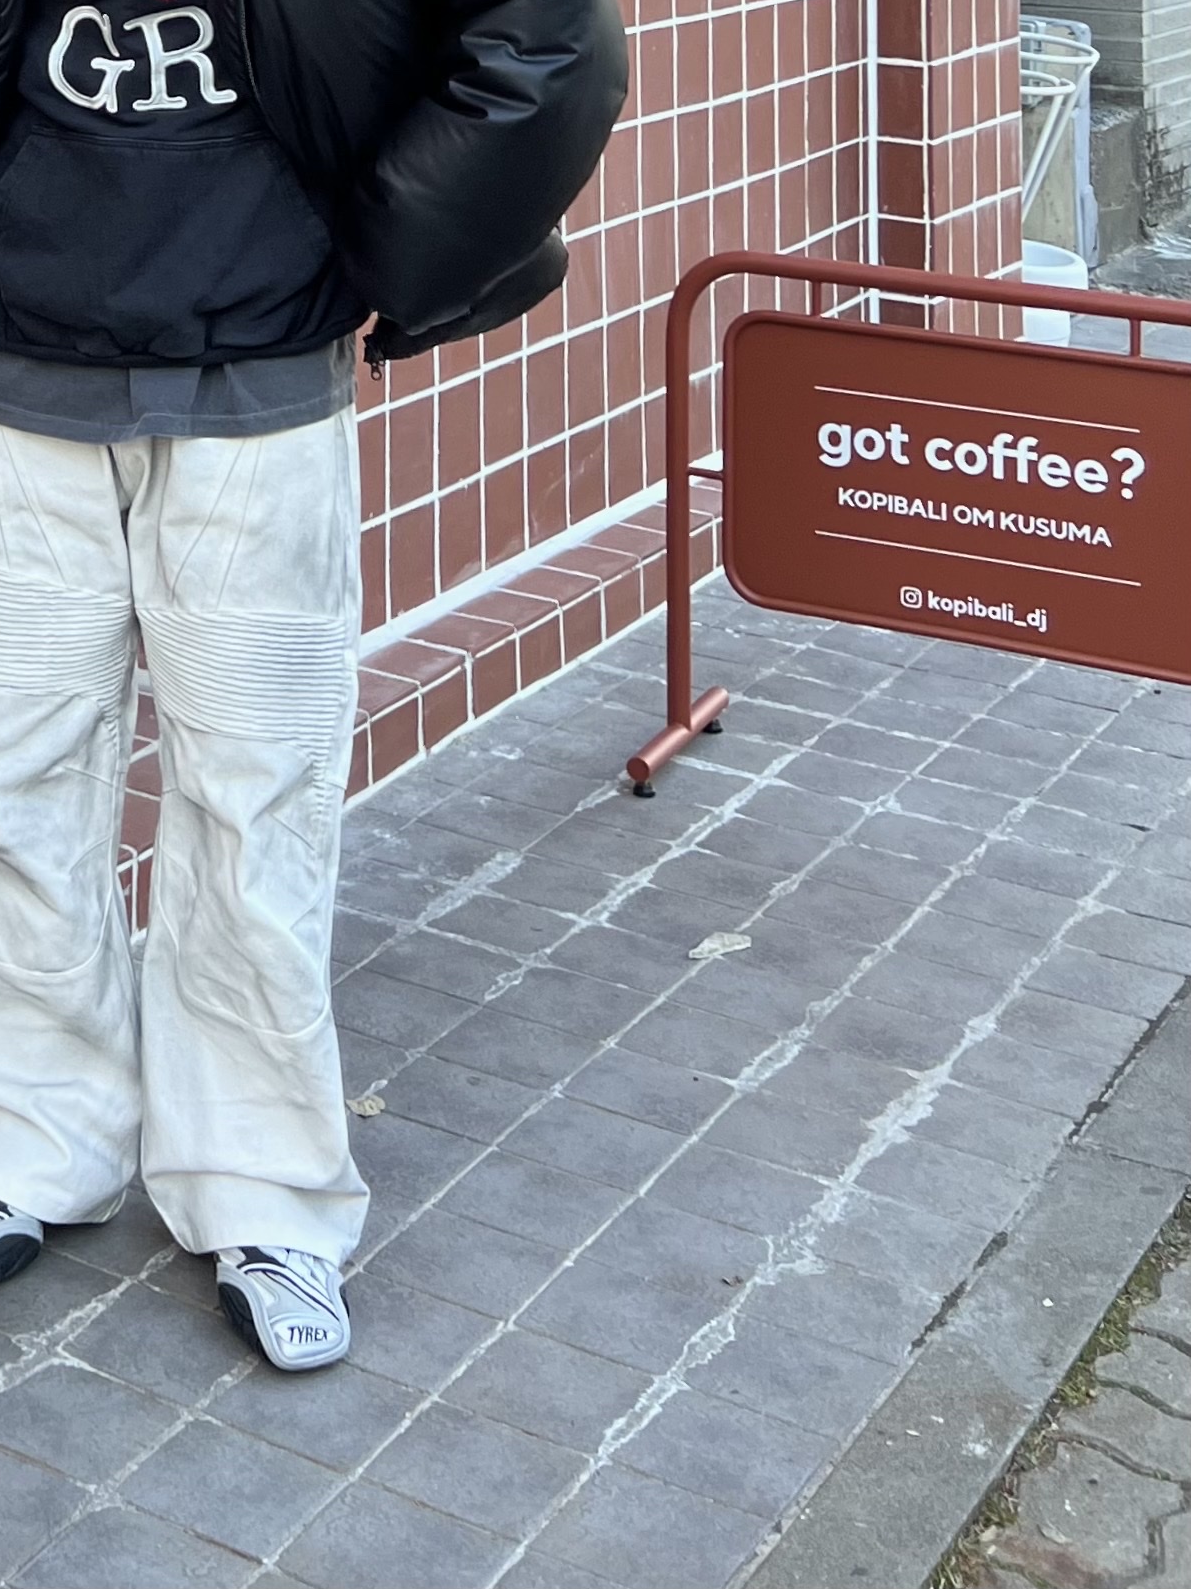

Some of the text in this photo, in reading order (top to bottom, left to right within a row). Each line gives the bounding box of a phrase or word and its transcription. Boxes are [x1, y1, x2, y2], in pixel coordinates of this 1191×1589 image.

[48, 5, 237, 113] GR
[818, 422, 1146, 500] got coffee?
[838, 487, 1112, 548] KOPIBALI OM KUSUMA
[927, 590, 1048, 632] kopibali_dj
[287, 1325, 328, 1344] TYREX
